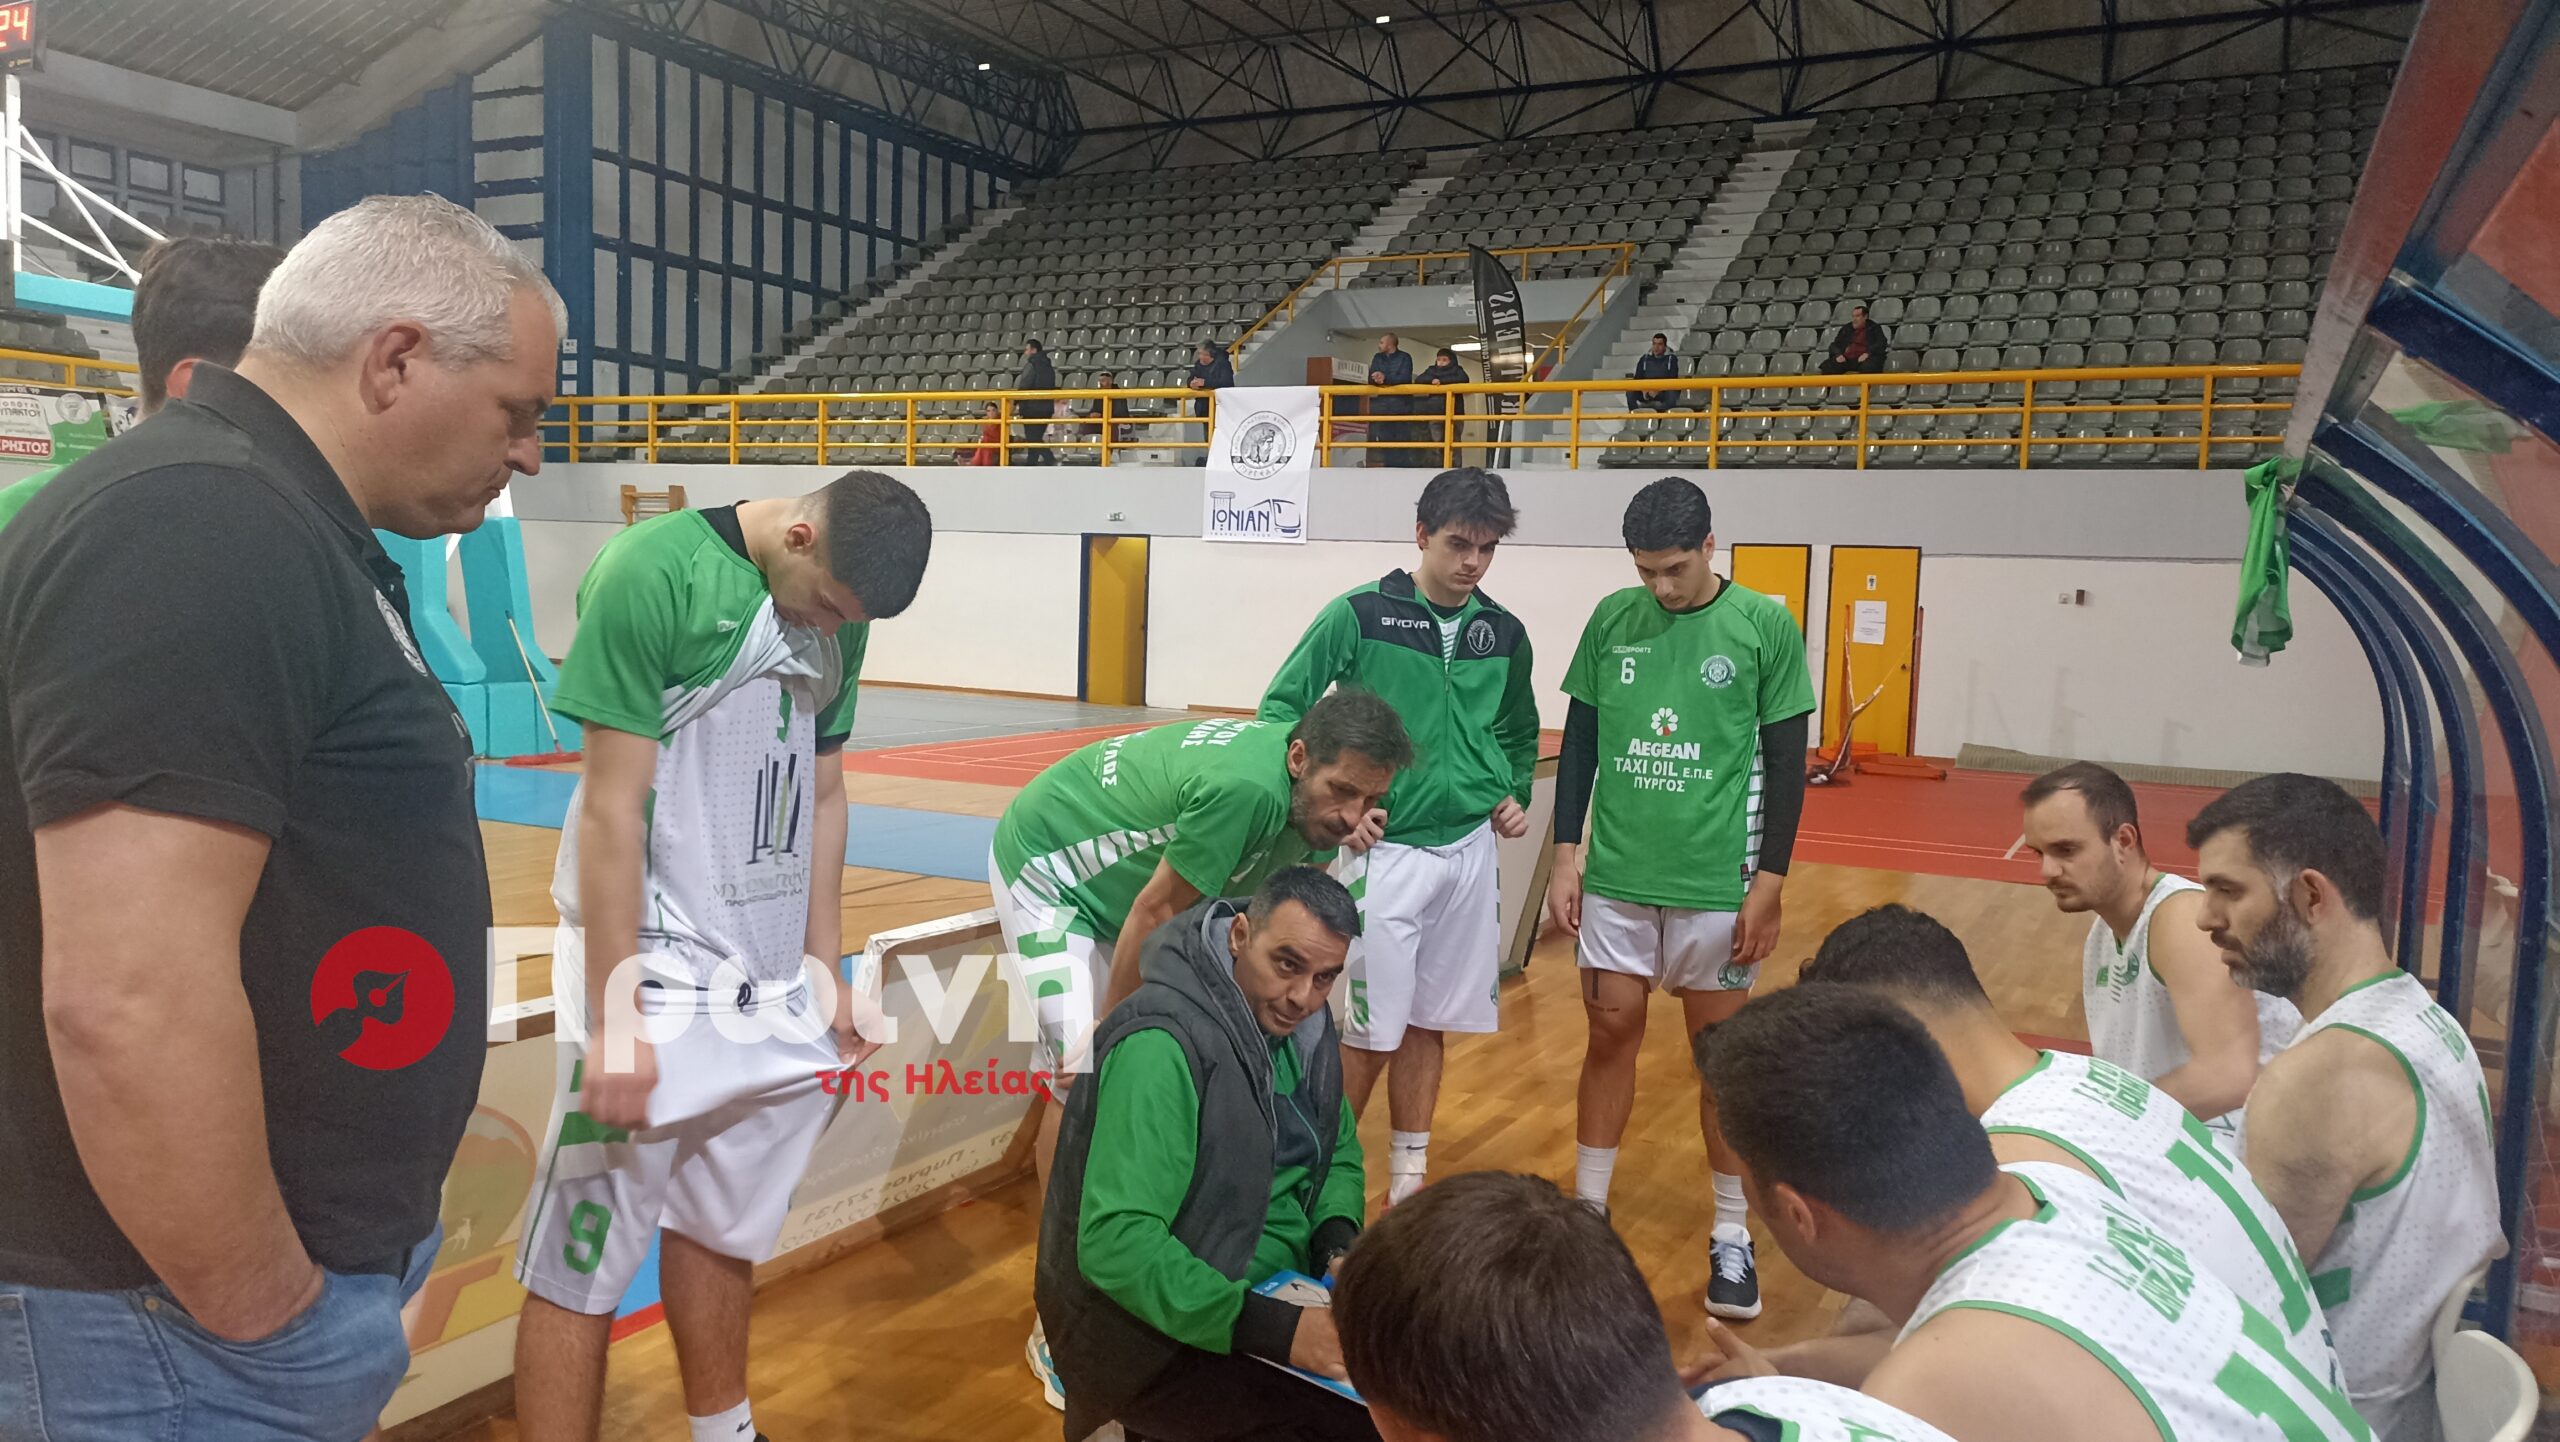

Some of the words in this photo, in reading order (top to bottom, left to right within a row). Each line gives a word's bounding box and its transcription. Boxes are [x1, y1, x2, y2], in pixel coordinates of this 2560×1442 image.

[1211, 509, 1270, 532] IONIAN
[1381, 617, 1430, 630] GIVOVA
[1621, 657, 1636, 685] 6
[1614, 757, 1647, 775] TAXI
[1652, 762, 1678, 777] OIL
[1634, 776, 1685, 793] ΠΥΡΓΟΣ
[563, 1200, 613, 1276] 9
